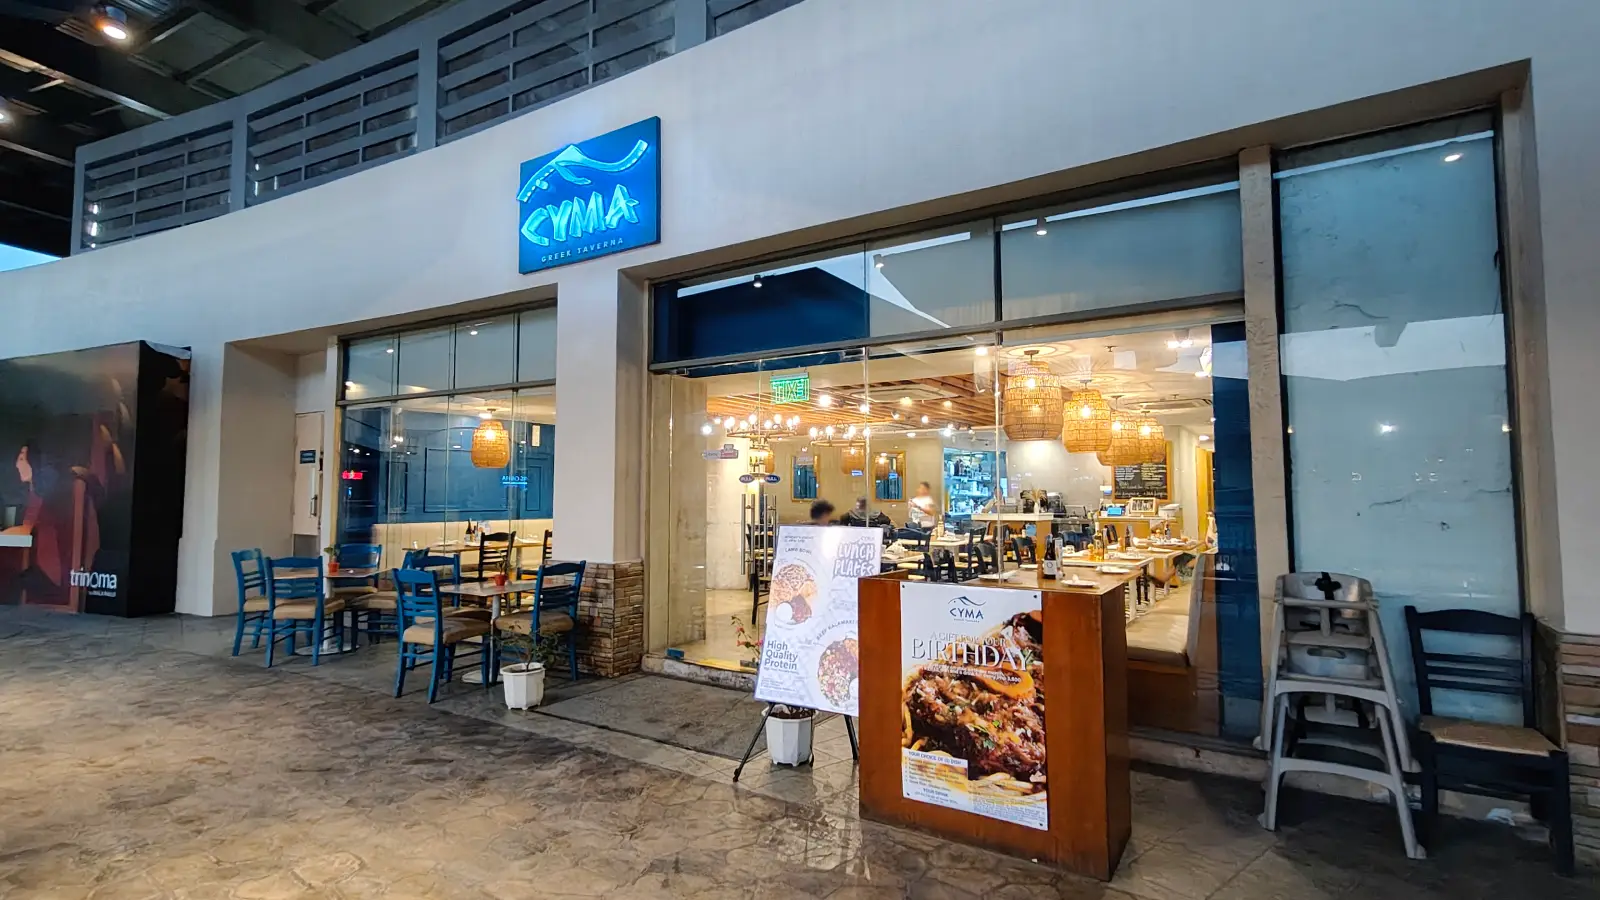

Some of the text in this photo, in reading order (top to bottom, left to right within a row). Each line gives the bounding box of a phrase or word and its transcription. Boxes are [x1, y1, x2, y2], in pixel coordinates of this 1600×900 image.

[521, 184, 639, 247] CYMA
[541, 237, 624, 263] GREEK TAVERNA
[949, 607, 984, 620] CYMA
[767, 640, 788, 652] High
[765, 649, 799, 662] Quality
[911, 638, 1033, 672] BIRTHDAY
[764, 658, 798, 671] Protein
